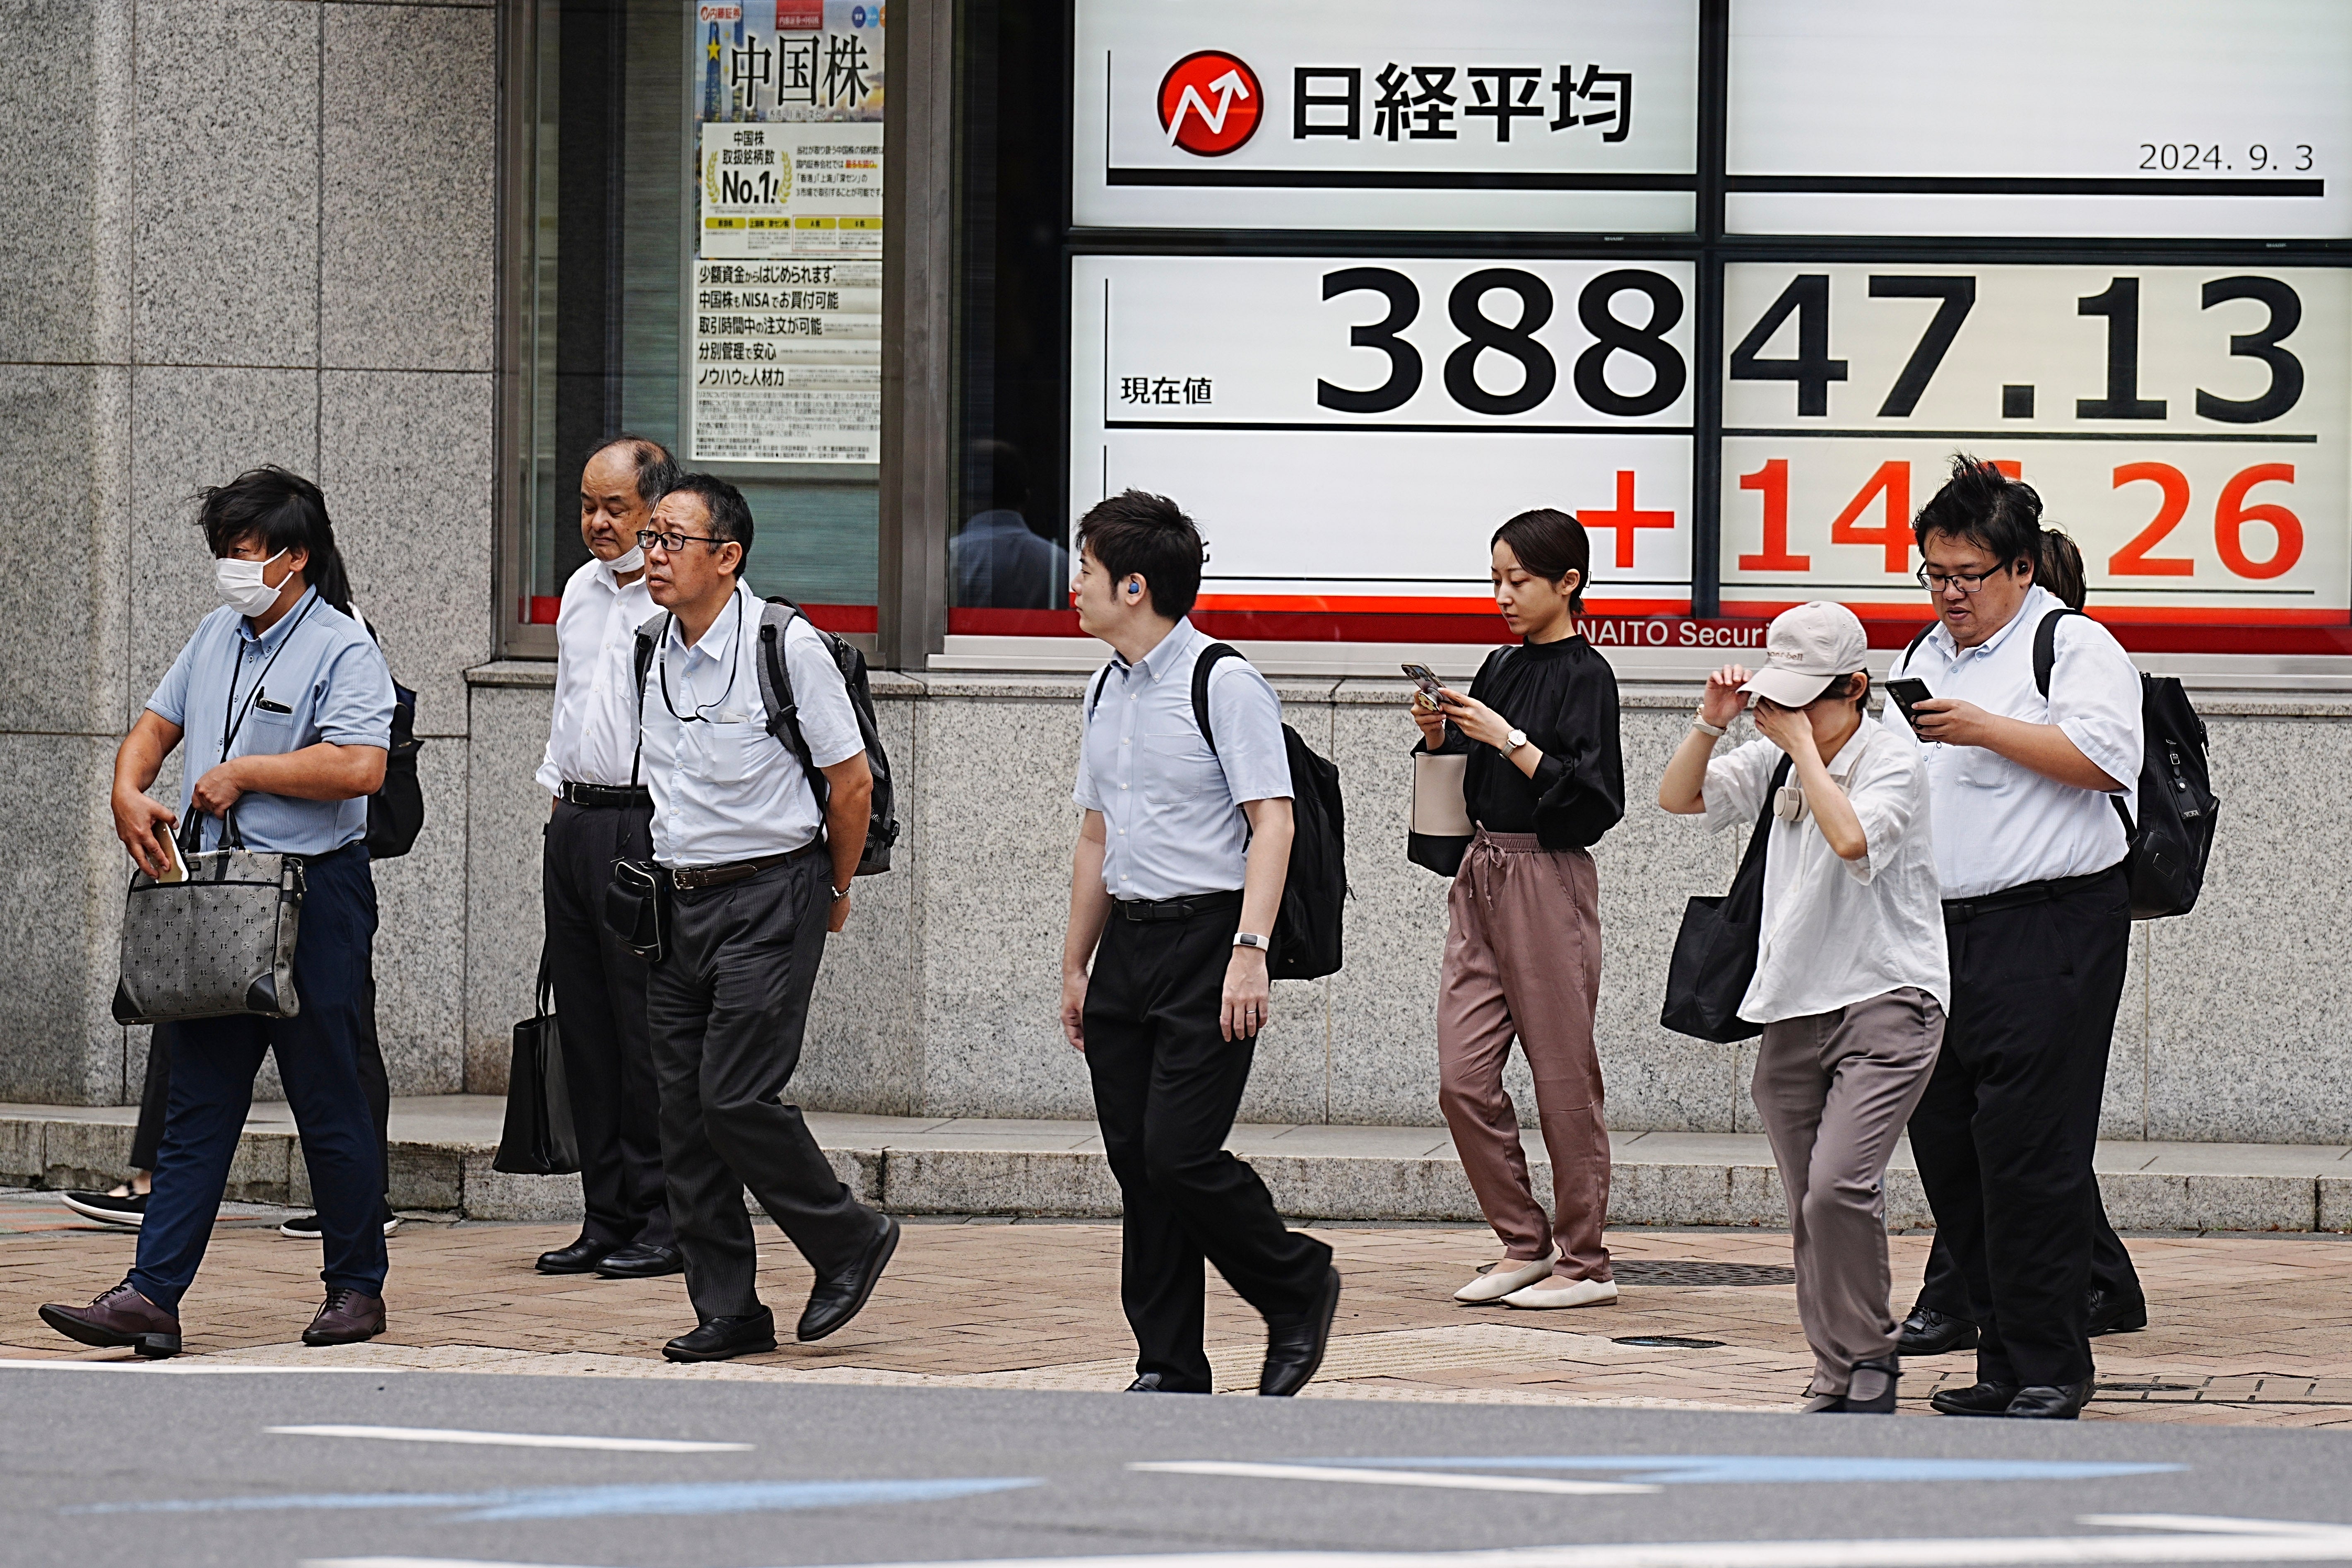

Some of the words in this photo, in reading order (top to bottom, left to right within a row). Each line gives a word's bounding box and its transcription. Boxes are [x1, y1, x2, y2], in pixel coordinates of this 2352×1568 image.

[731, 34, 869, 108] 中国株
[1293, 62, 1632, 142] 日経平均
[734, 130, 765, 147] 中国株
[722, 149, 775, 165] 取扱銘柄数
[2139, 144, 2232, 171] 2024.
[2248, 145, 2277, 171] 9.
[2295, 145, 2313, 171] 3
[722, 171, 779, 204] No.1!
[700, 265, 833, 284] 少額資金からはじめられます
[699, 316, 823, 336] 取引時間中の注文が可能
[699, 342, 777, 361] 分別管理で安心
[699, 368, 784, 387] ノウハウと人材力
[1120, 376, 1212, 405] 現在値
[1578, 620, 1668, 646] NAITO
